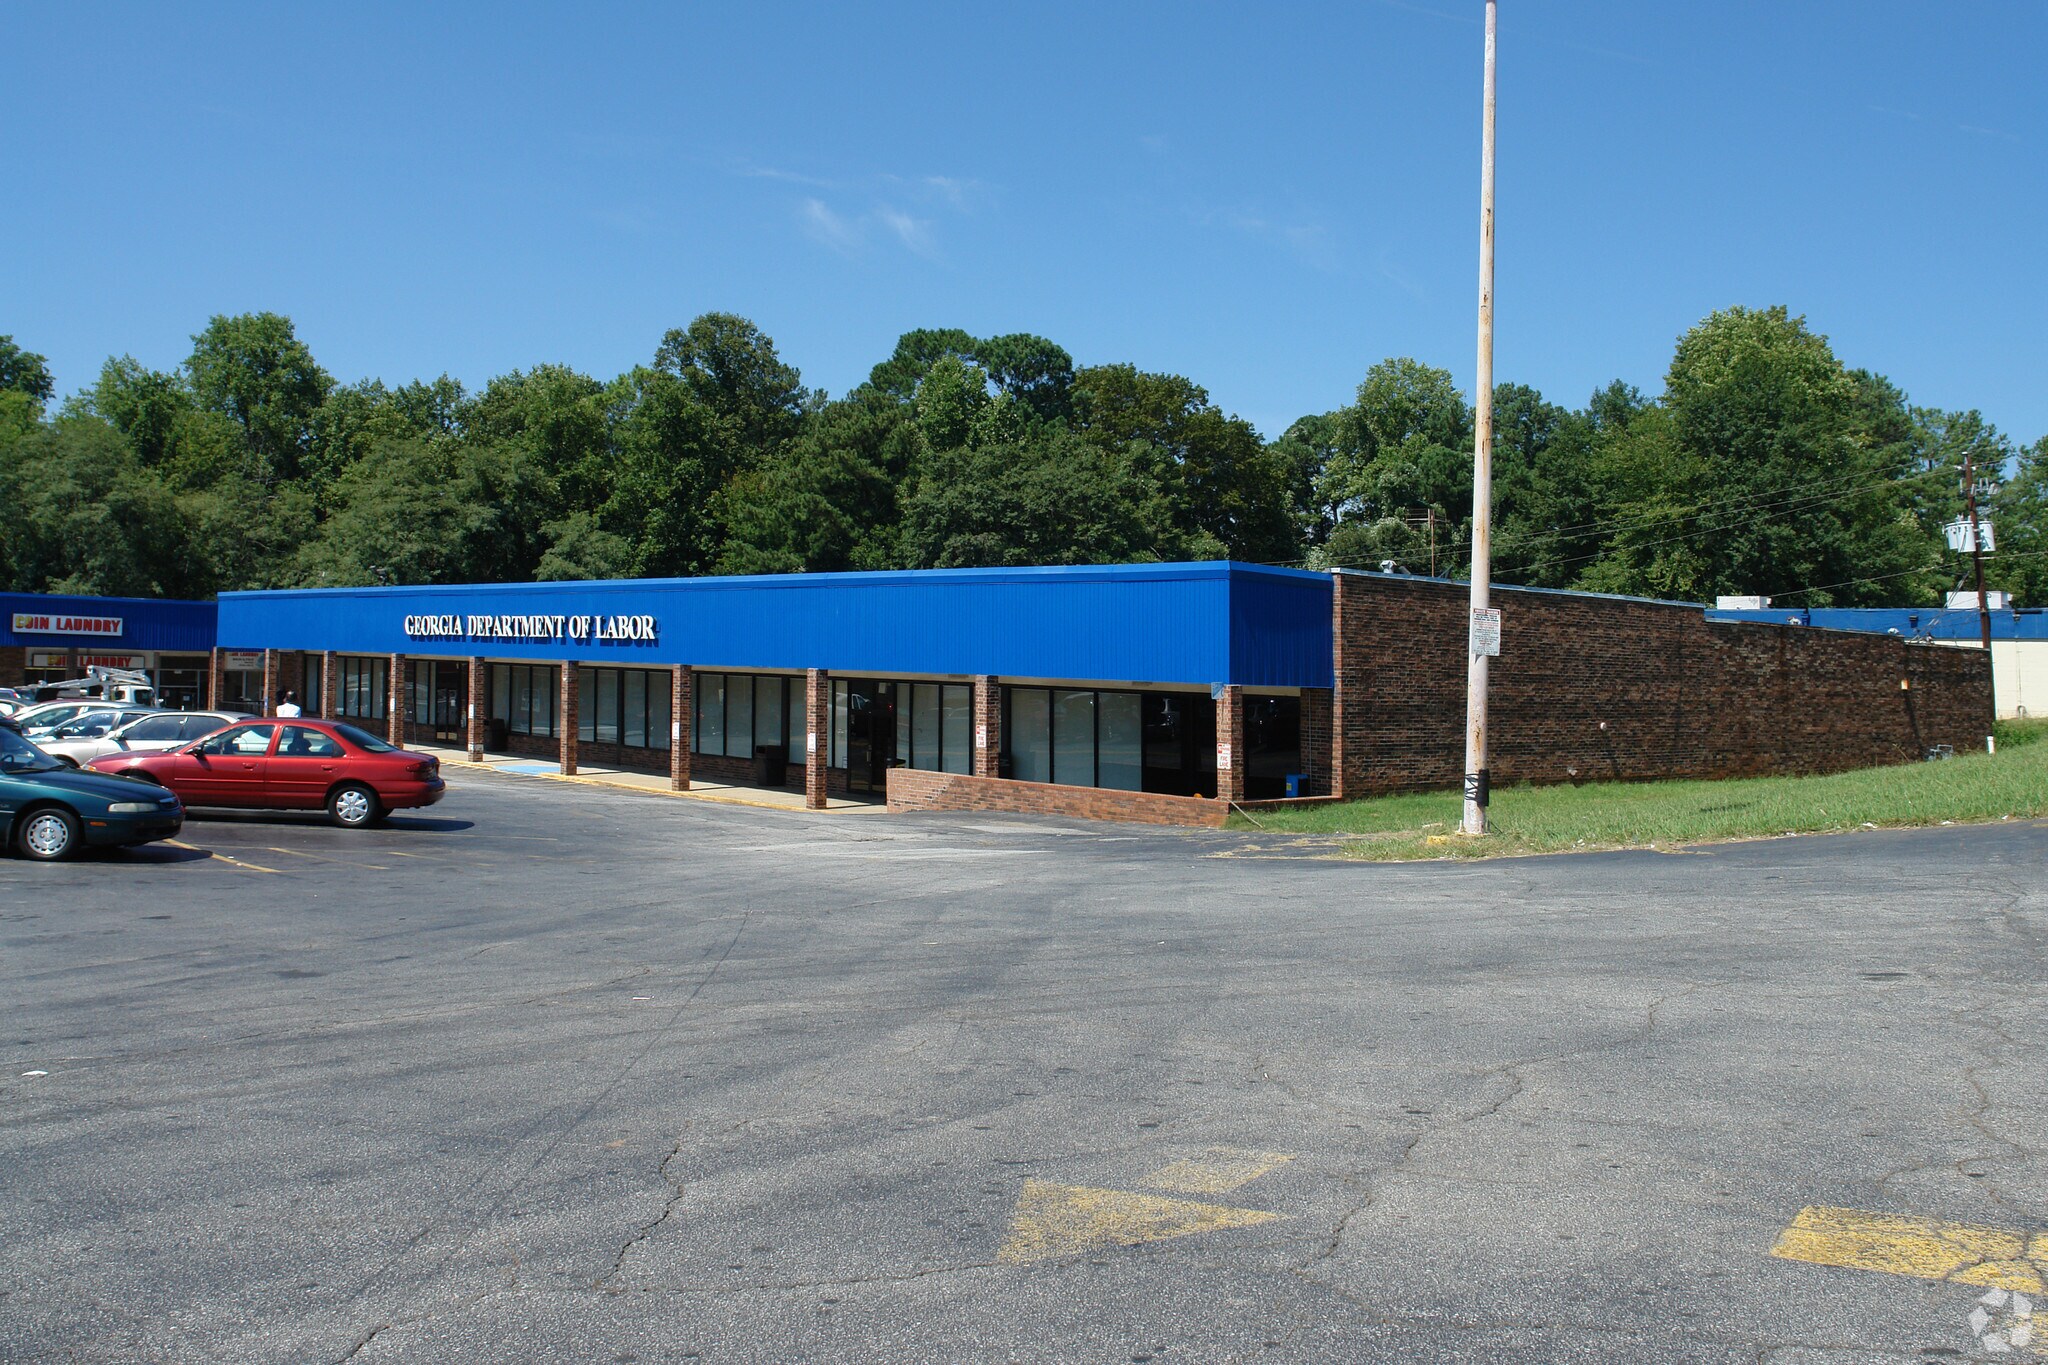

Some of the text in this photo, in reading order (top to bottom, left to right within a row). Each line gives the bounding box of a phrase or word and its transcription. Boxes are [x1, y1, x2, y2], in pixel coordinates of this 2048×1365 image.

[15, 615, 121, 633] COIN LAUNDRY
[404, 614, 656, 640] GEORGIA DEPARTMENT OF LABOR
[80, 656, 131, 667] LAUNDRY
